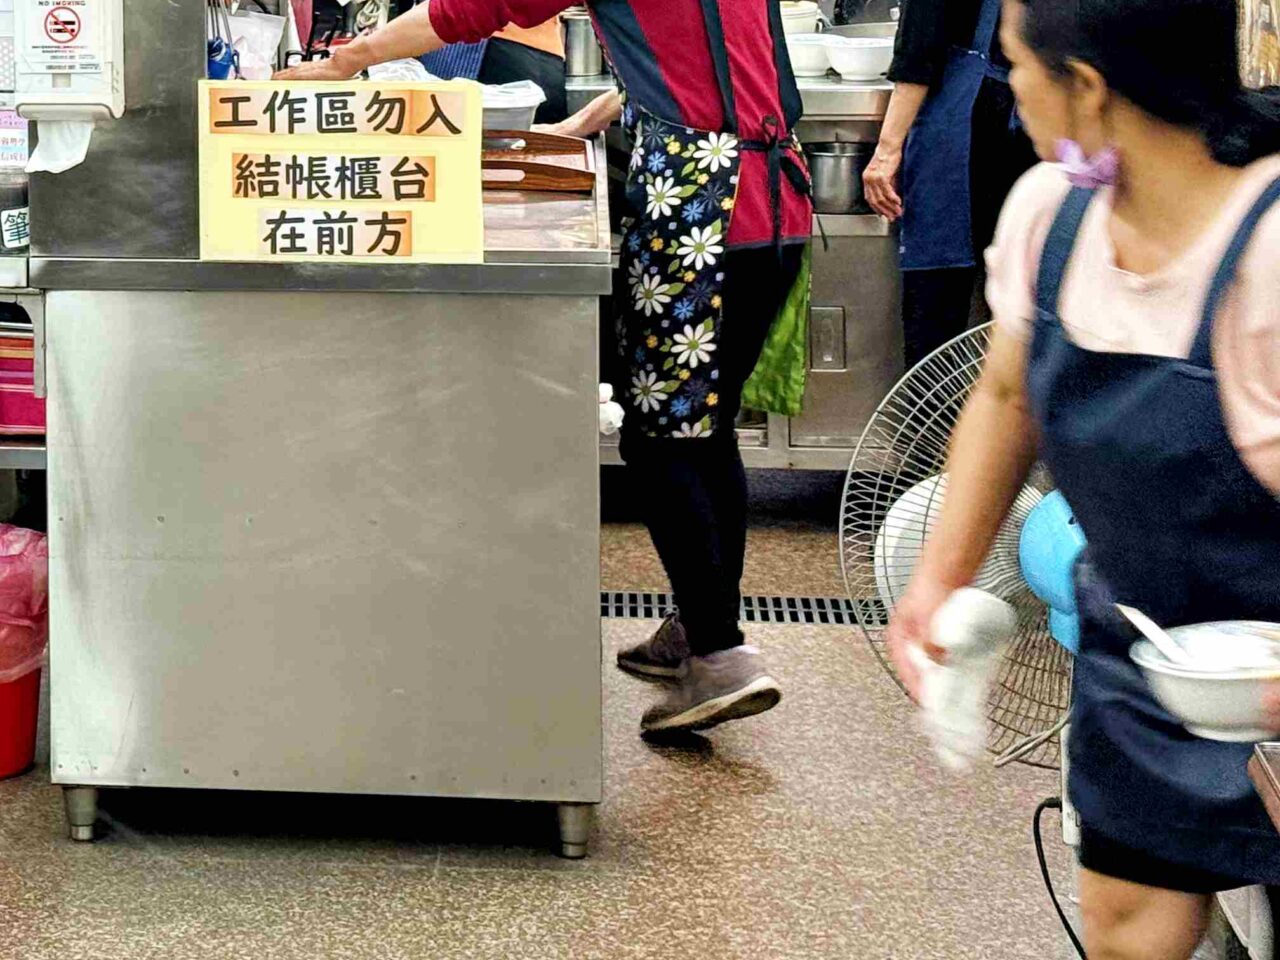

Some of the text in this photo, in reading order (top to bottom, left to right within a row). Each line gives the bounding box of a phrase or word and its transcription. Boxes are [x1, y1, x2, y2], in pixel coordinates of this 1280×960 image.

[213, 89, 463, 135] 工作區勿入
[234, 153, 431, 202] 結帳櫃台
[3, 210, 31, 245] 筆
[262, 209, 408, 257] 在前方
